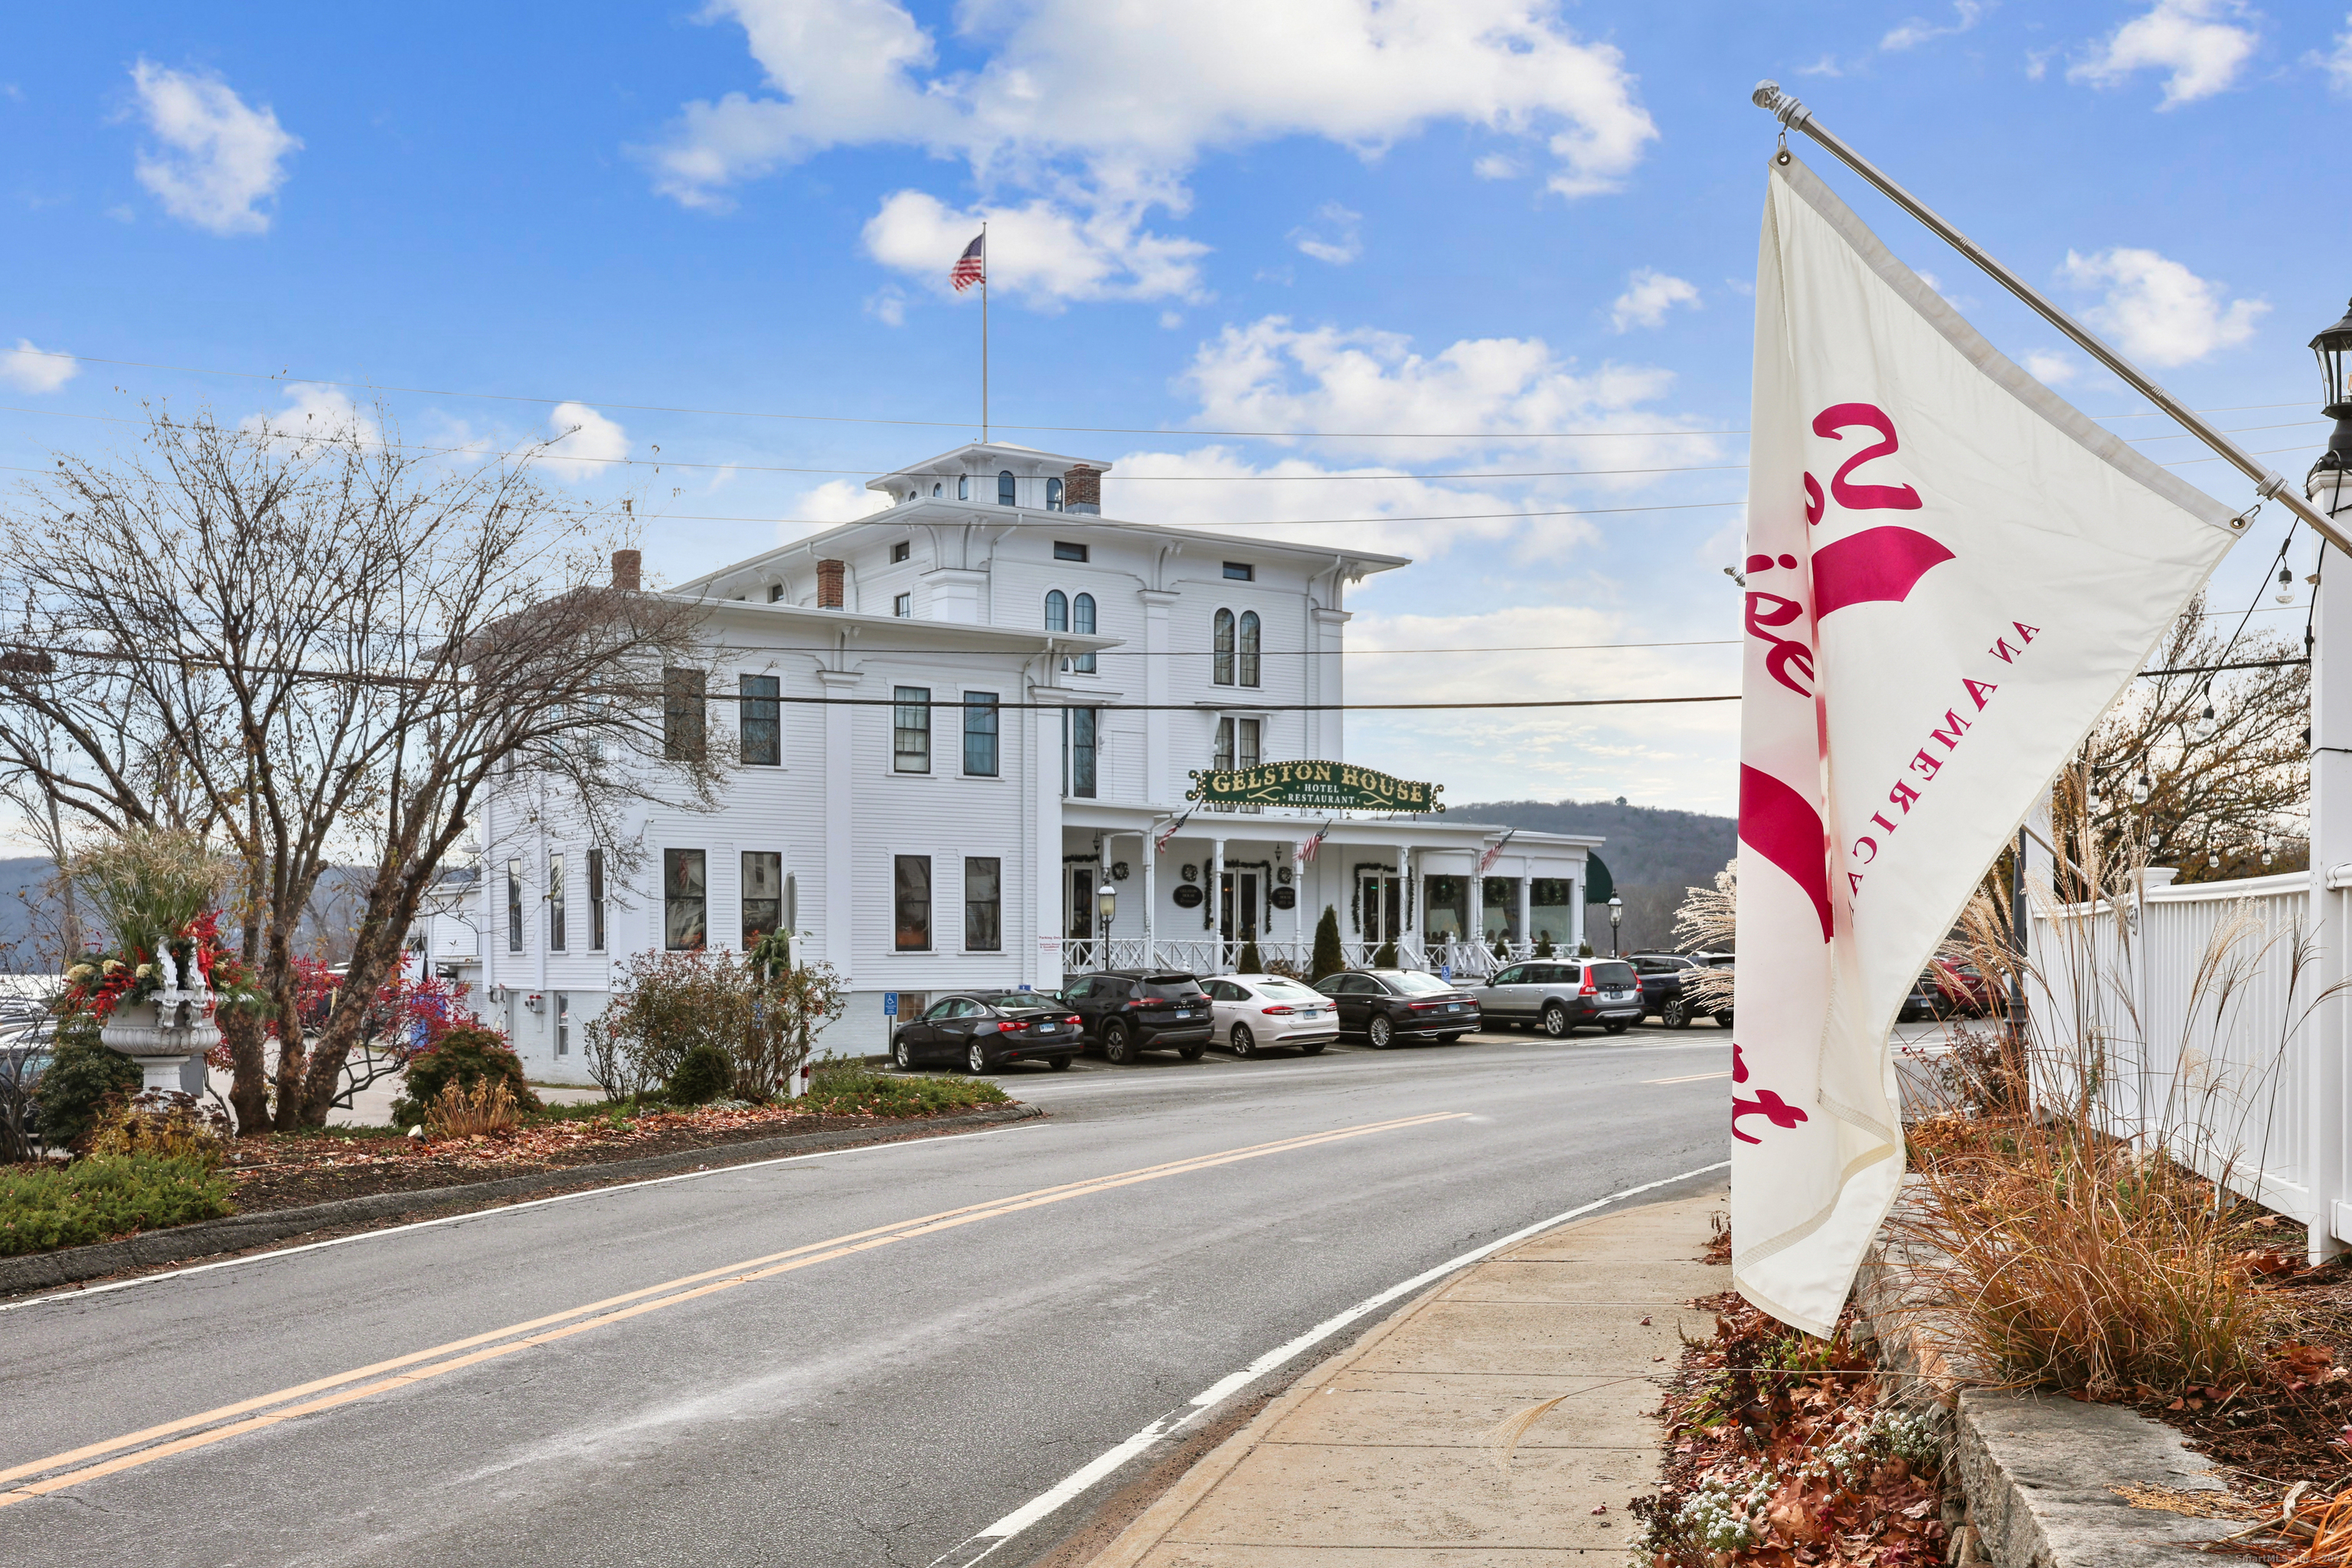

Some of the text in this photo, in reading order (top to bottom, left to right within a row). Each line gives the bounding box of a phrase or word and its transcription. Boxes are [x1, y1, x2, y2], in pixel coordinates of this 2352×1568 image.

[1212, 764, 1423, 802] GELSTON HOUSE
[1304, 783, 1339, 793] HOTEL
[1288, 793, 1355, 804] RESTAURANT
